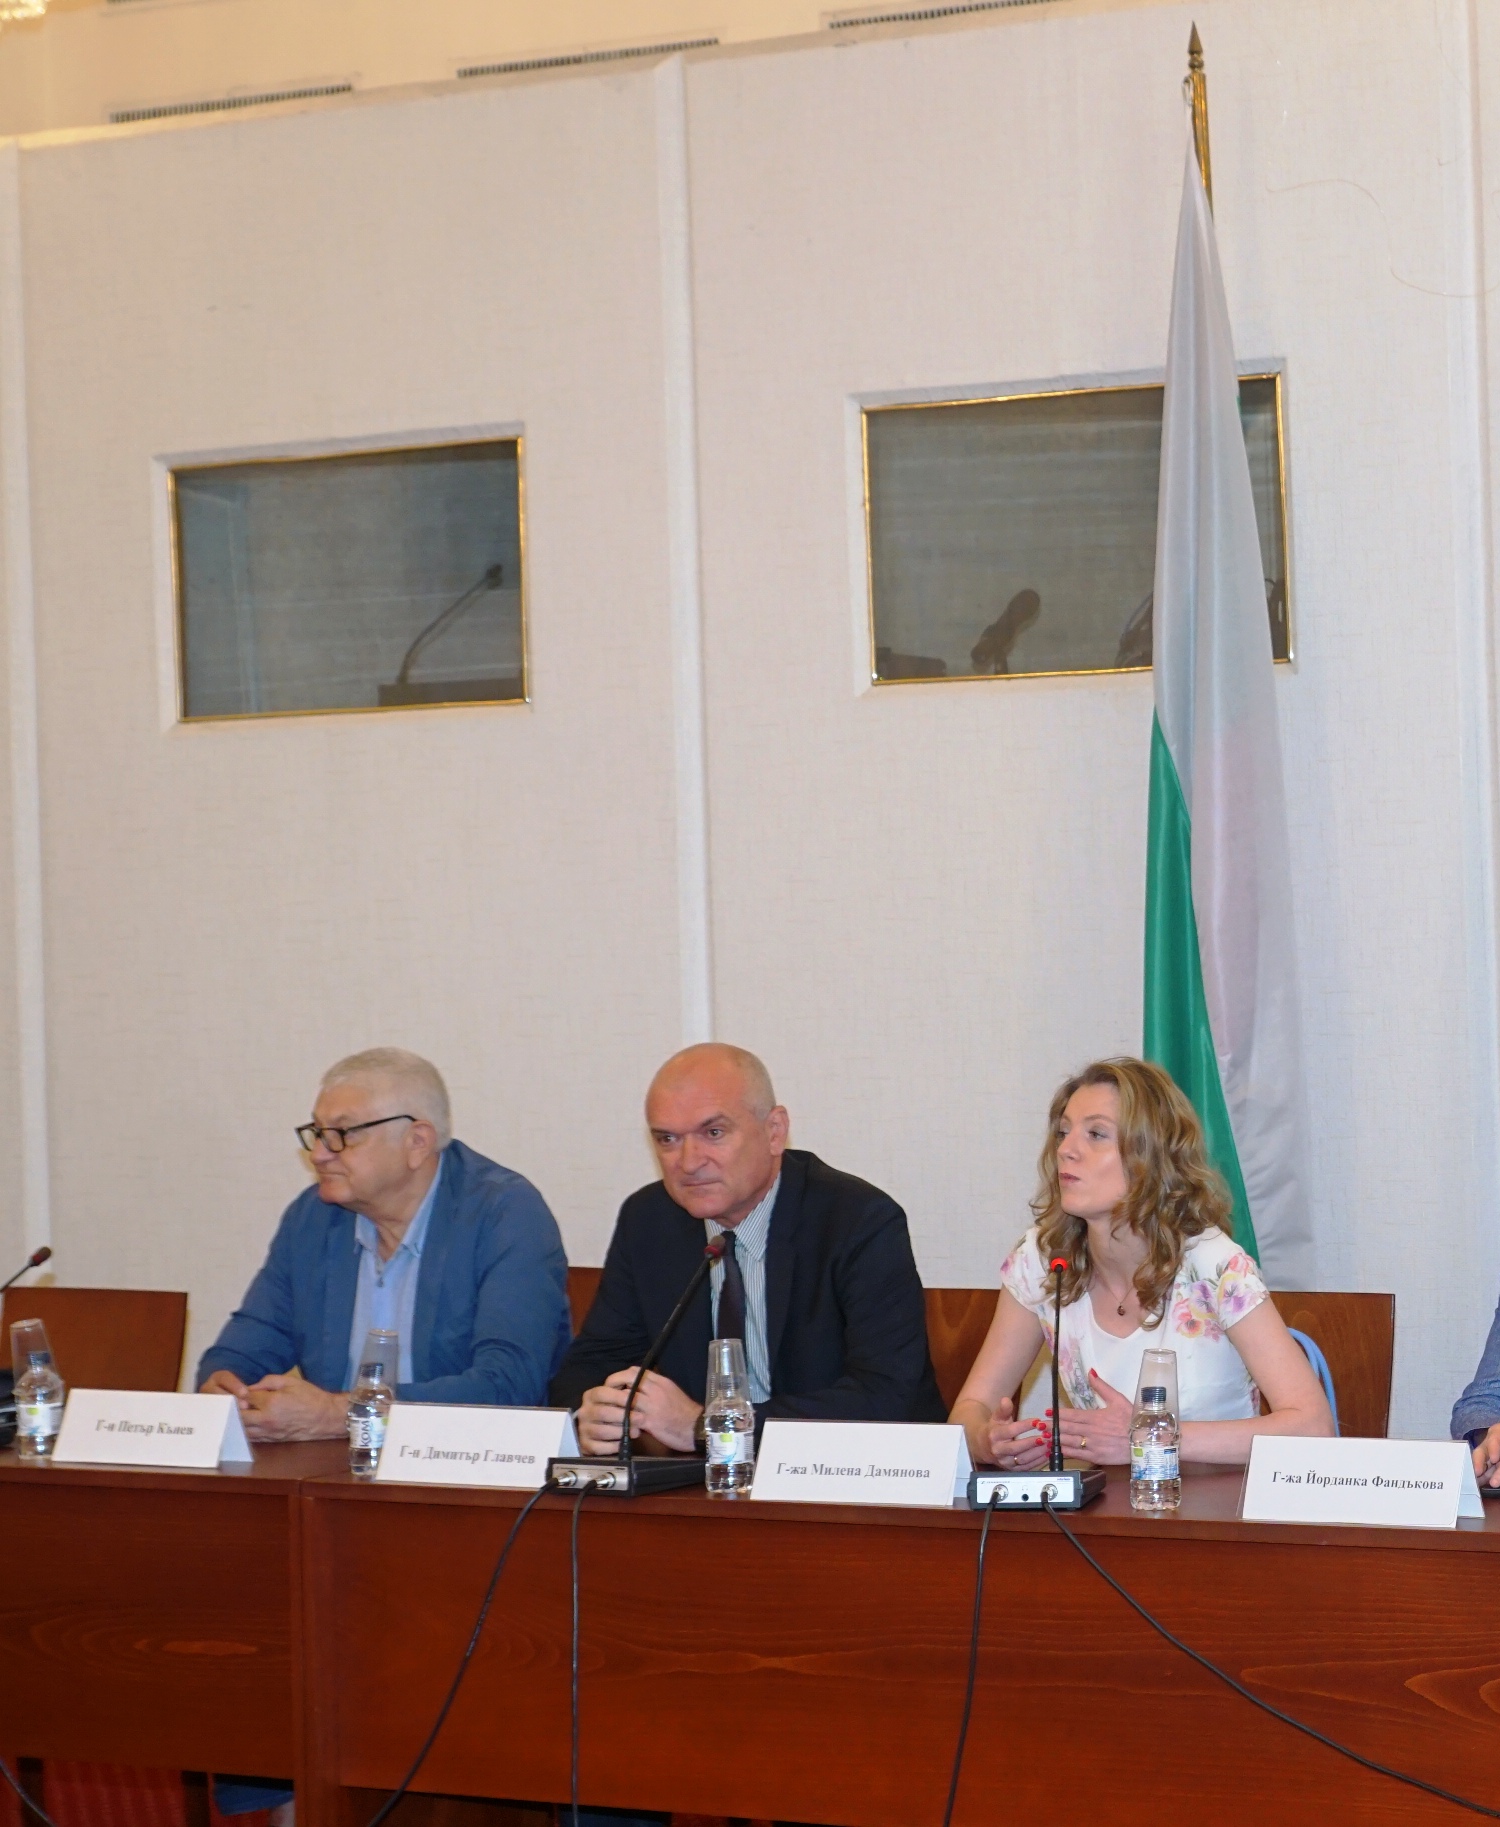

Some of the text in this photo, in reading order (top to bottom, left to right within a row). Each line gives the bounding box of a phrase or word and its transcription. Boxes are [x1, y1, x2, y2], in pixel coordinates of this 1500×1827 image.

[95, 1419, 116, 1432] Г-н
[117, 1420, 154, 1436] Петър
[400, 1445, 536, 1464] Г-н Димитър Главчев
[776, 1462, 930, 1478] Г-жа Милена Дамянова
[1272, 1470, 1444, 1490] Г-жа Йорданка Фандъкова
